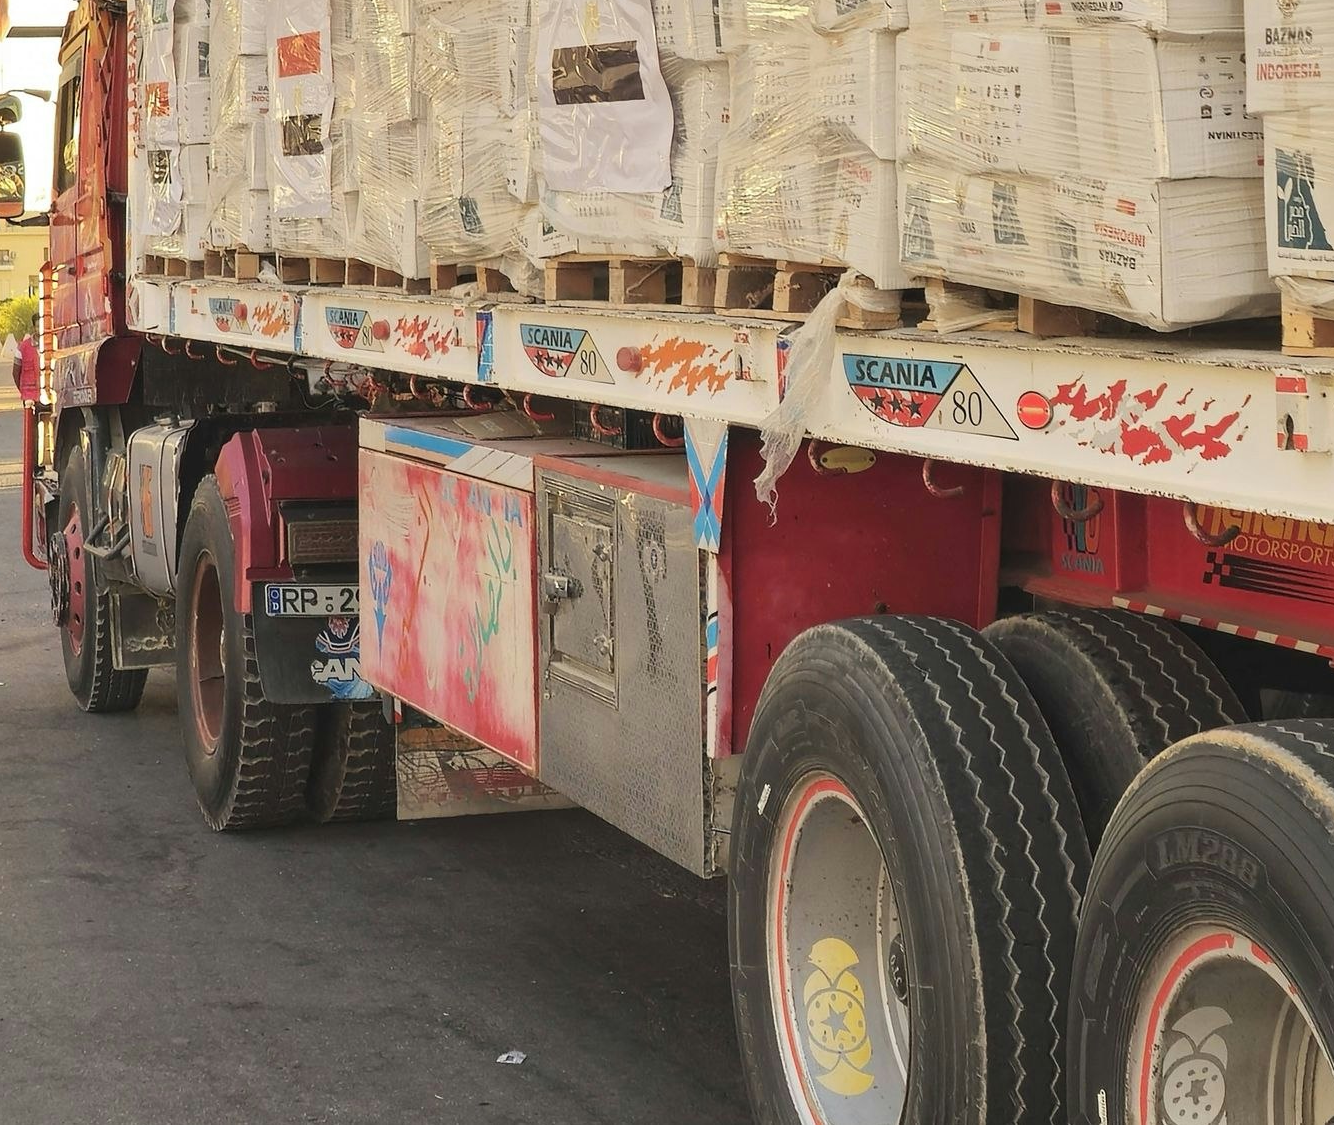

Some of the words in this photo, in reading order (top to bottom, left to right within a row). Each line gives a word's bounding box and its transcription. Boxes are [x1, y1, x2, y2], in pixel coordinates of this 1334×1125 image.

[1265, 26, 1314, 46] BAZNAS
[1256, 62, 1322, 82] INDONESIA
[329, 309, 359, 326] SCANIA
[361, 325, 374, 347] 80
[526, 328, 574, 350] SCANIA
[580, 350, 598, 376] 80
[855, 359, 938, 389] SCANIA
[952, 390, 983, 427] 80
[1060, 553, 1106, 576] SCANIA
